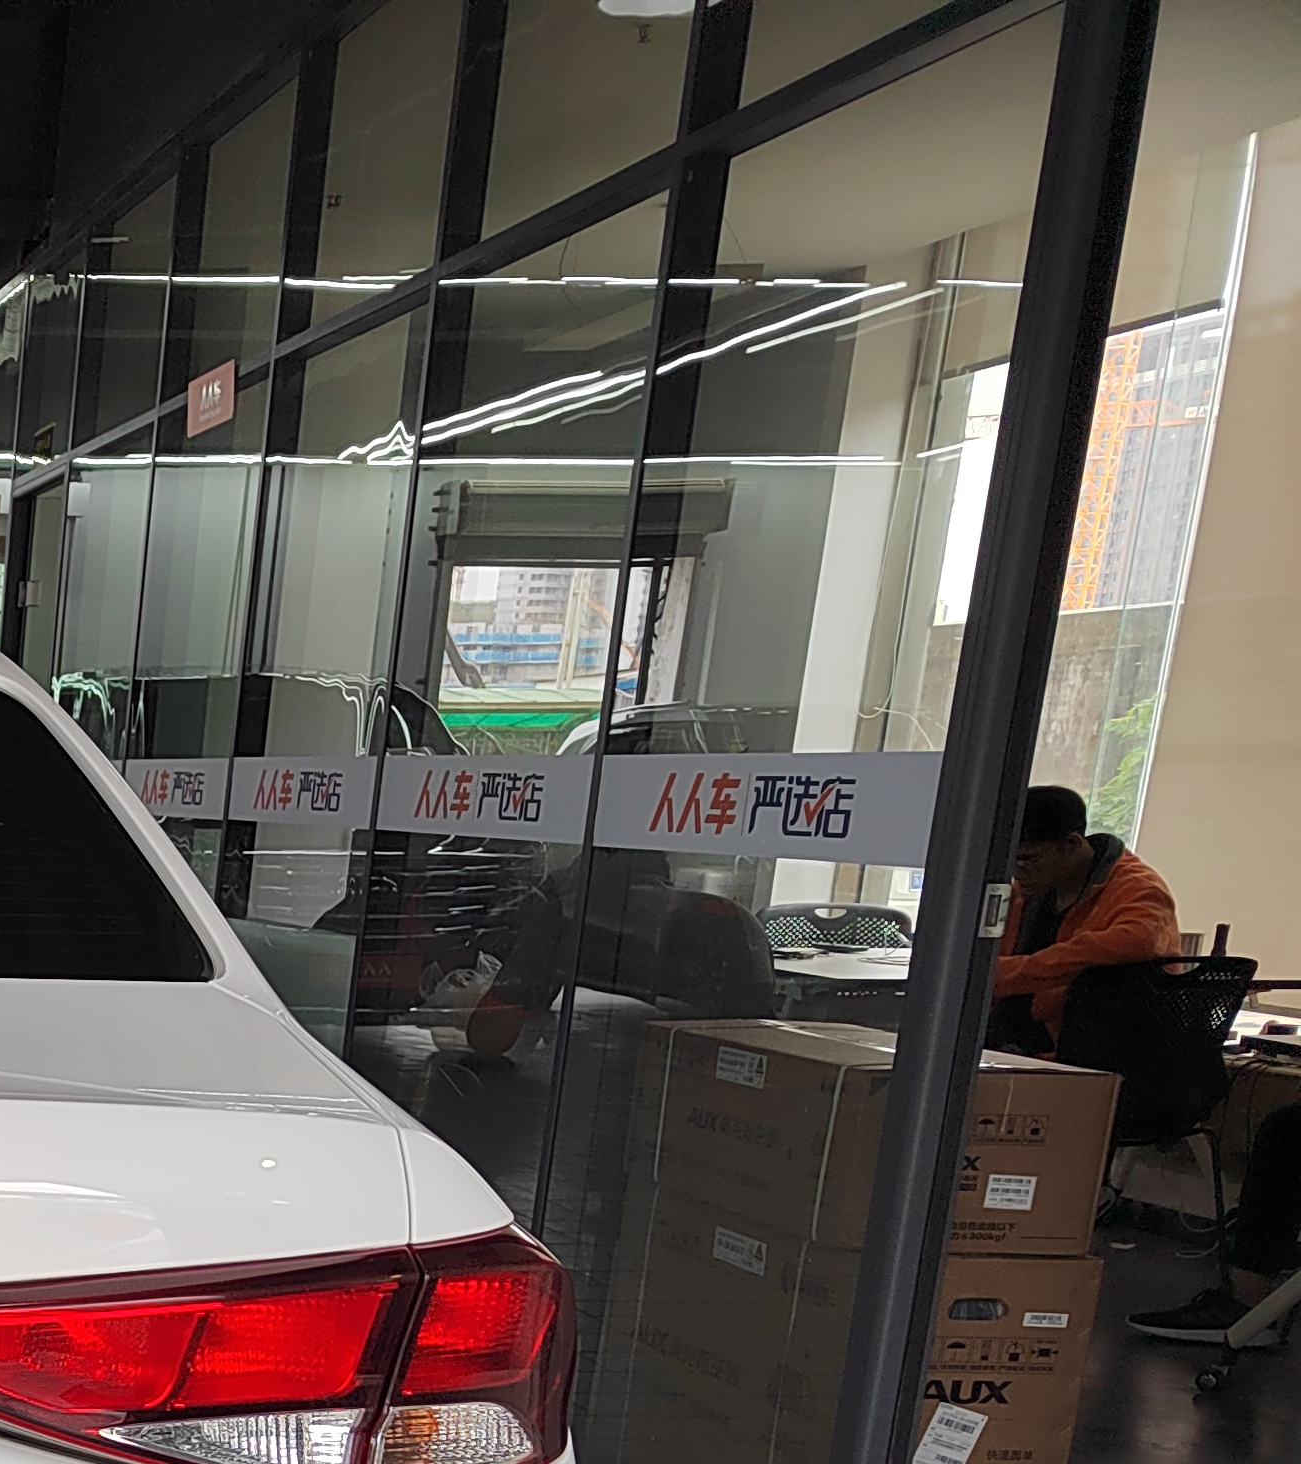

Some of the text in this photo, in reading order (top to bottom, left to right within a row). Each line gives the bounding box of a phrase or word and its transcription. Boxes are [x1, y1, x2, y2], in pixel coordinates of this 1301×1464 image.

[140, 769, 205, 806] 人人车 严选店
[253, 769, 343, 812] 人人车 严选店
[414, 769, 545, 822] 人人车 严选店
[648, 772, 857, 839] 人人车 严选店
[924, 1379, 1012, 1405] AUX
